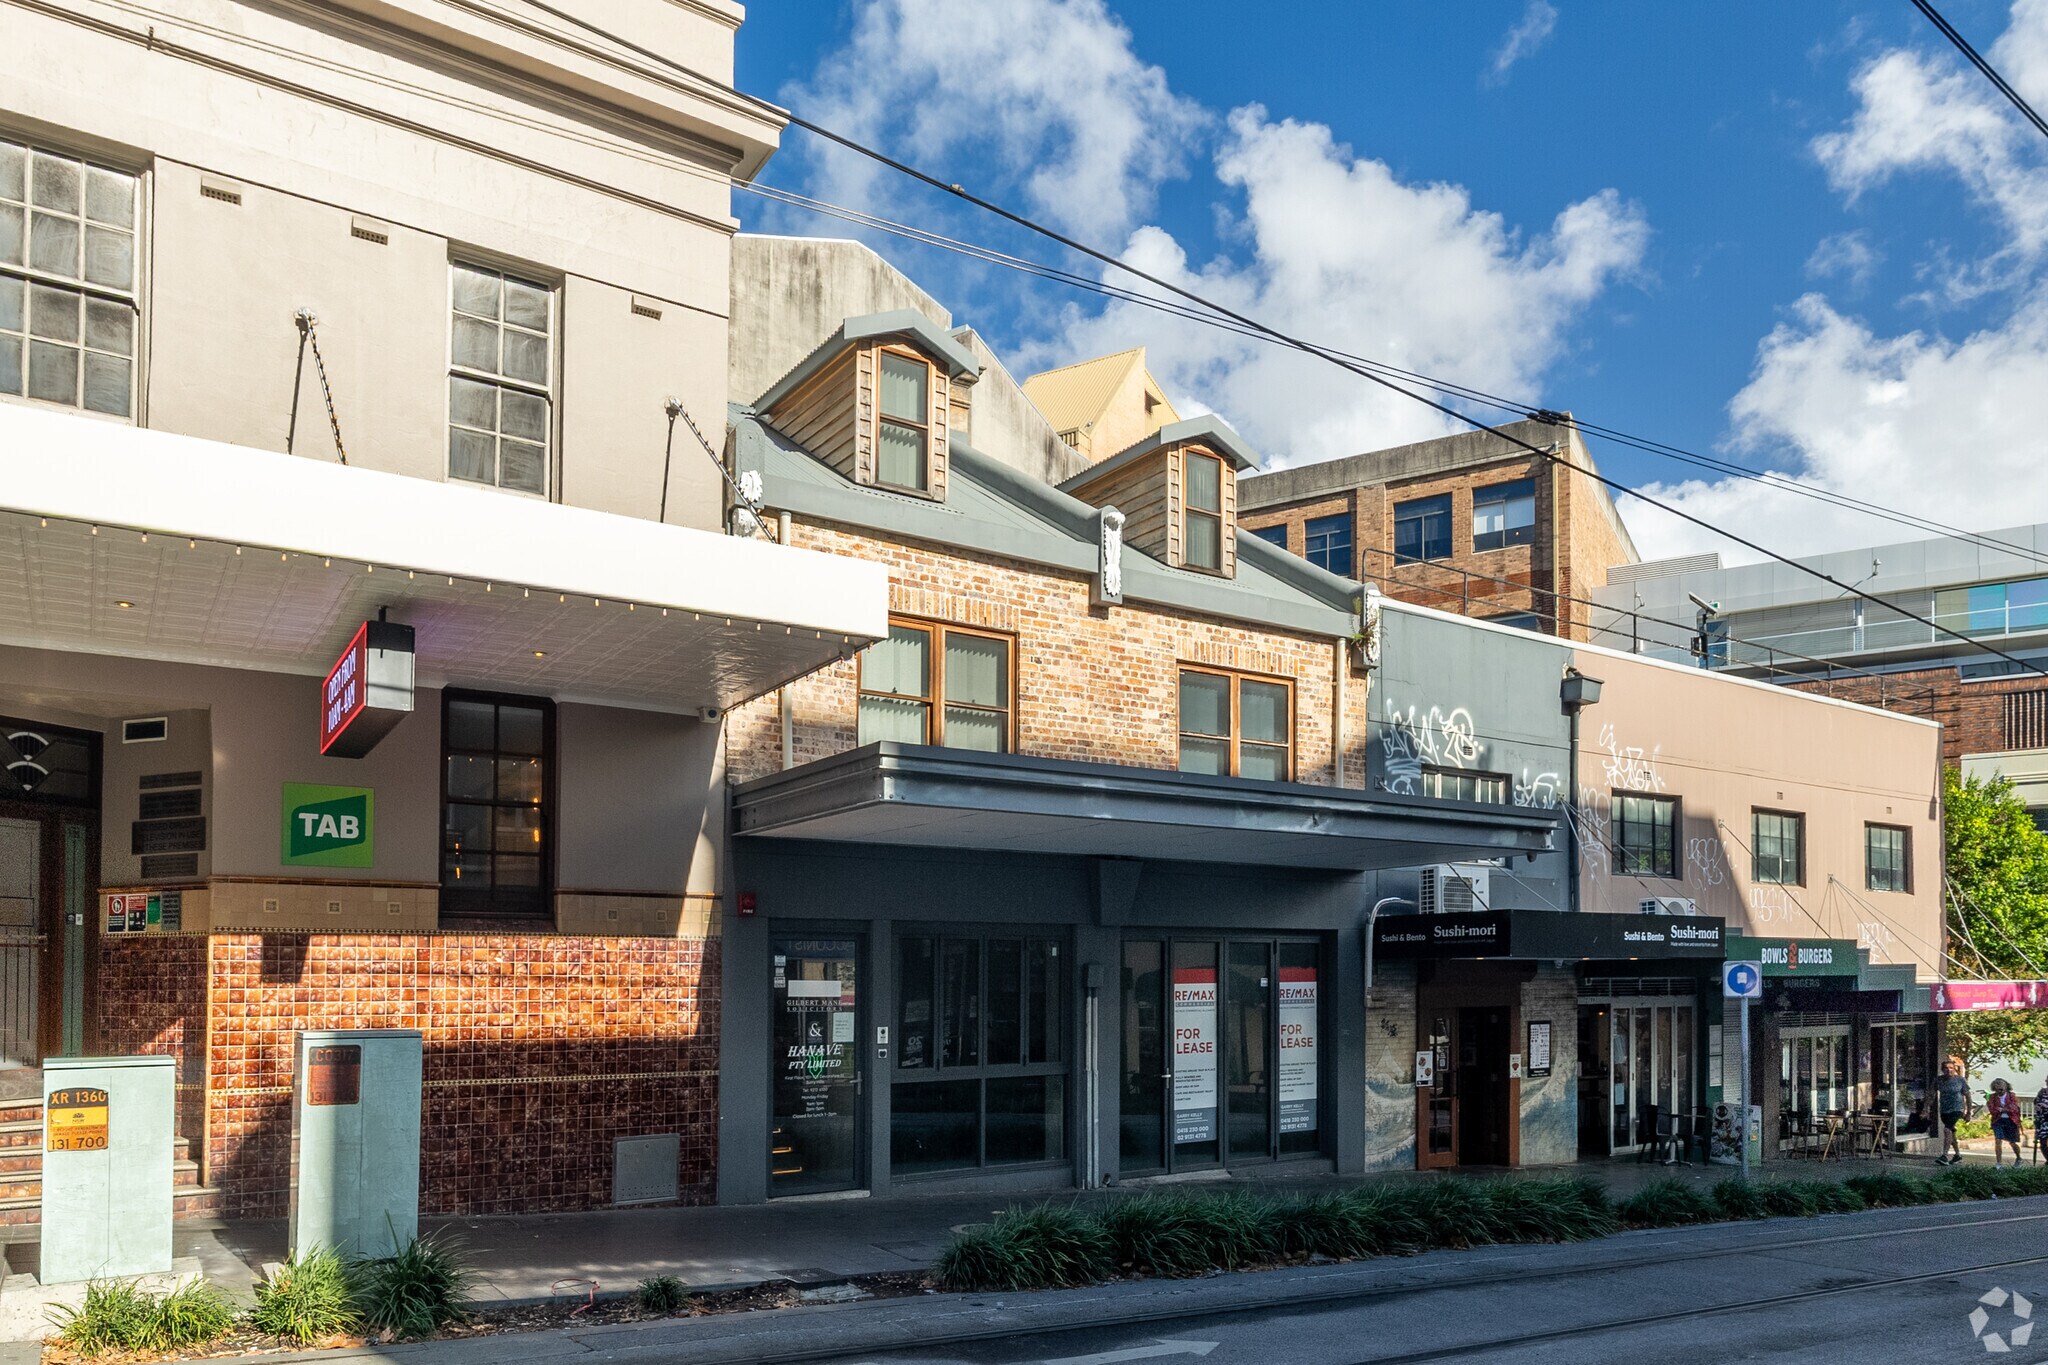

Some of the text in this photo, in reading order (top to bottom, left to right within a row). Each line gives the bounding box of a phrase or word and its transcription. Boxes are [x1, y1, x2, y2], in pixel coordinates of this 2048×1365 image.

[328, 647, 356, 704] OPEN FROM
[298, 813, 359, 839] TAB
[1433, 923, 1496, 937] Sushi-mori
[1624, 931, 1664, 941] Sushi & Bento
[1670, 925, 1719, 939] Sushi-mori
[1381, 934, 1399, 942] Sushi
[1406, 933, 1426, 941] Bento
[1761, 948, 1787, 964] BOWLS
[1798, 948, 1833, 964] BURGERS
[1175, 990, 1214, 1001] RE/MAX
[1280, 988, 1315, 999] RE/MAX
[809, 1022, 822, 1037] &
[1176, 1028, 1200, 1040] FOR
[1280, 1024, 1302, 1035] FOR
[1176, 1042, 1213, 1054] LEASE
[1280, 1037, 1313, 1049] LEASE
[788, 1043, 842, 1057] HANAVE
[788, 1059, 842, 1070] PTY LIMITED
[51, 1090, 107, 1104] XR 1360
[51, 1136, 105, 1150] 131 700
